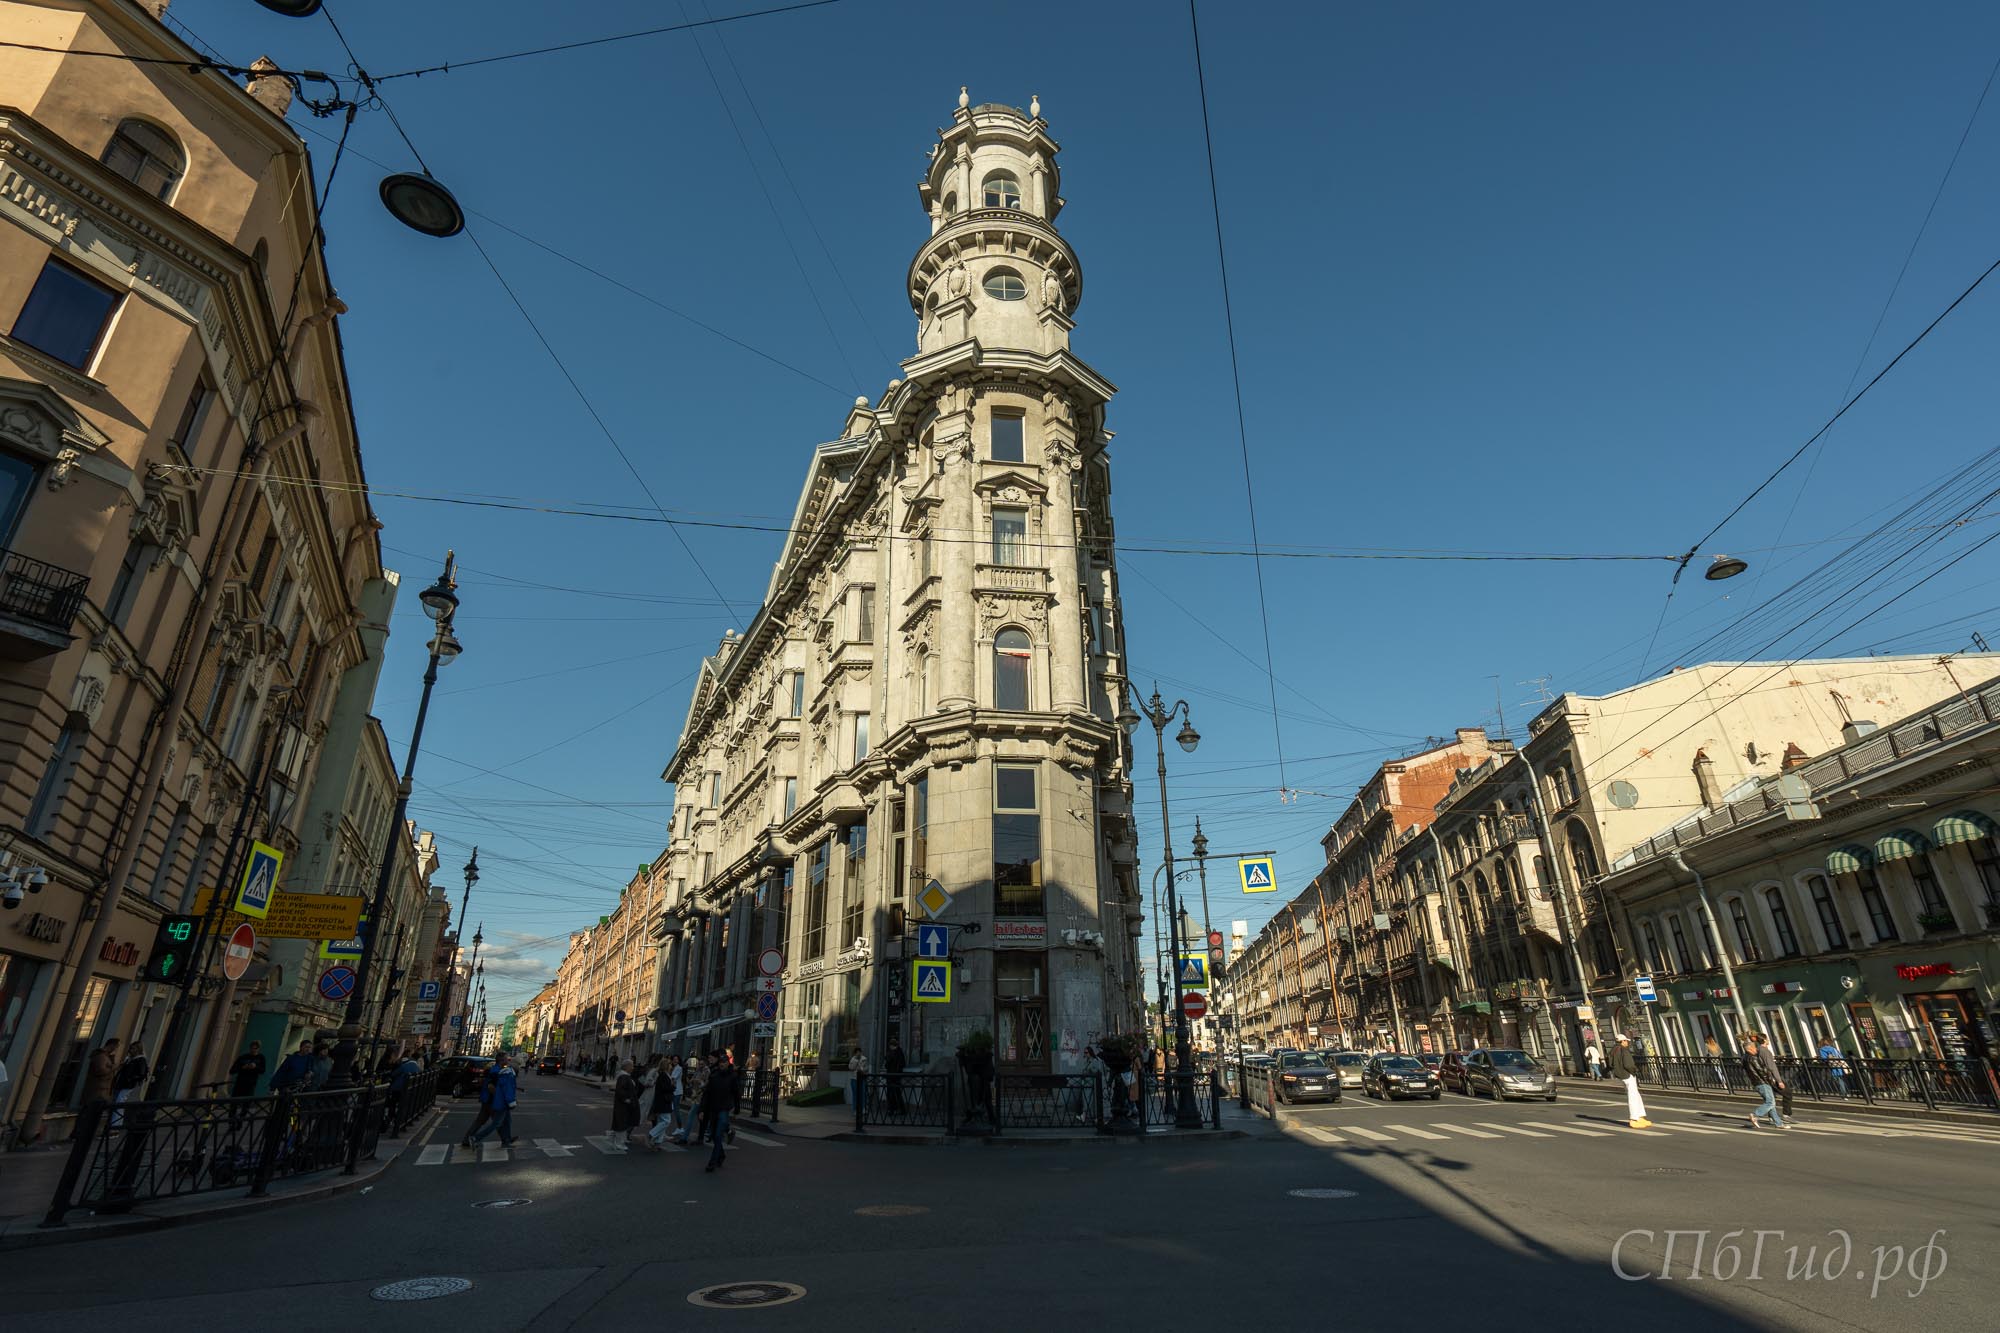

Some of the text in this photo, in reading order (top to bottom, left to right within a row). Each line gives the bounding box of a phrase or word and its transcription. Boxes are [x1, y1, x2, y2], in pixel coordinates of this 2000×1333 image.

[288, 902, 347, 911] РУБИНШТЕЙНА
[308, 916, 345, 924] СУББОТЫ
[168, 922, 191, 940] 48
[295, 922, 353, 931] ВОСКРЕСЕНЬЯ
[994, 922, 1046, 934] bileter
[303, 929, 321, 937] ДНИ
